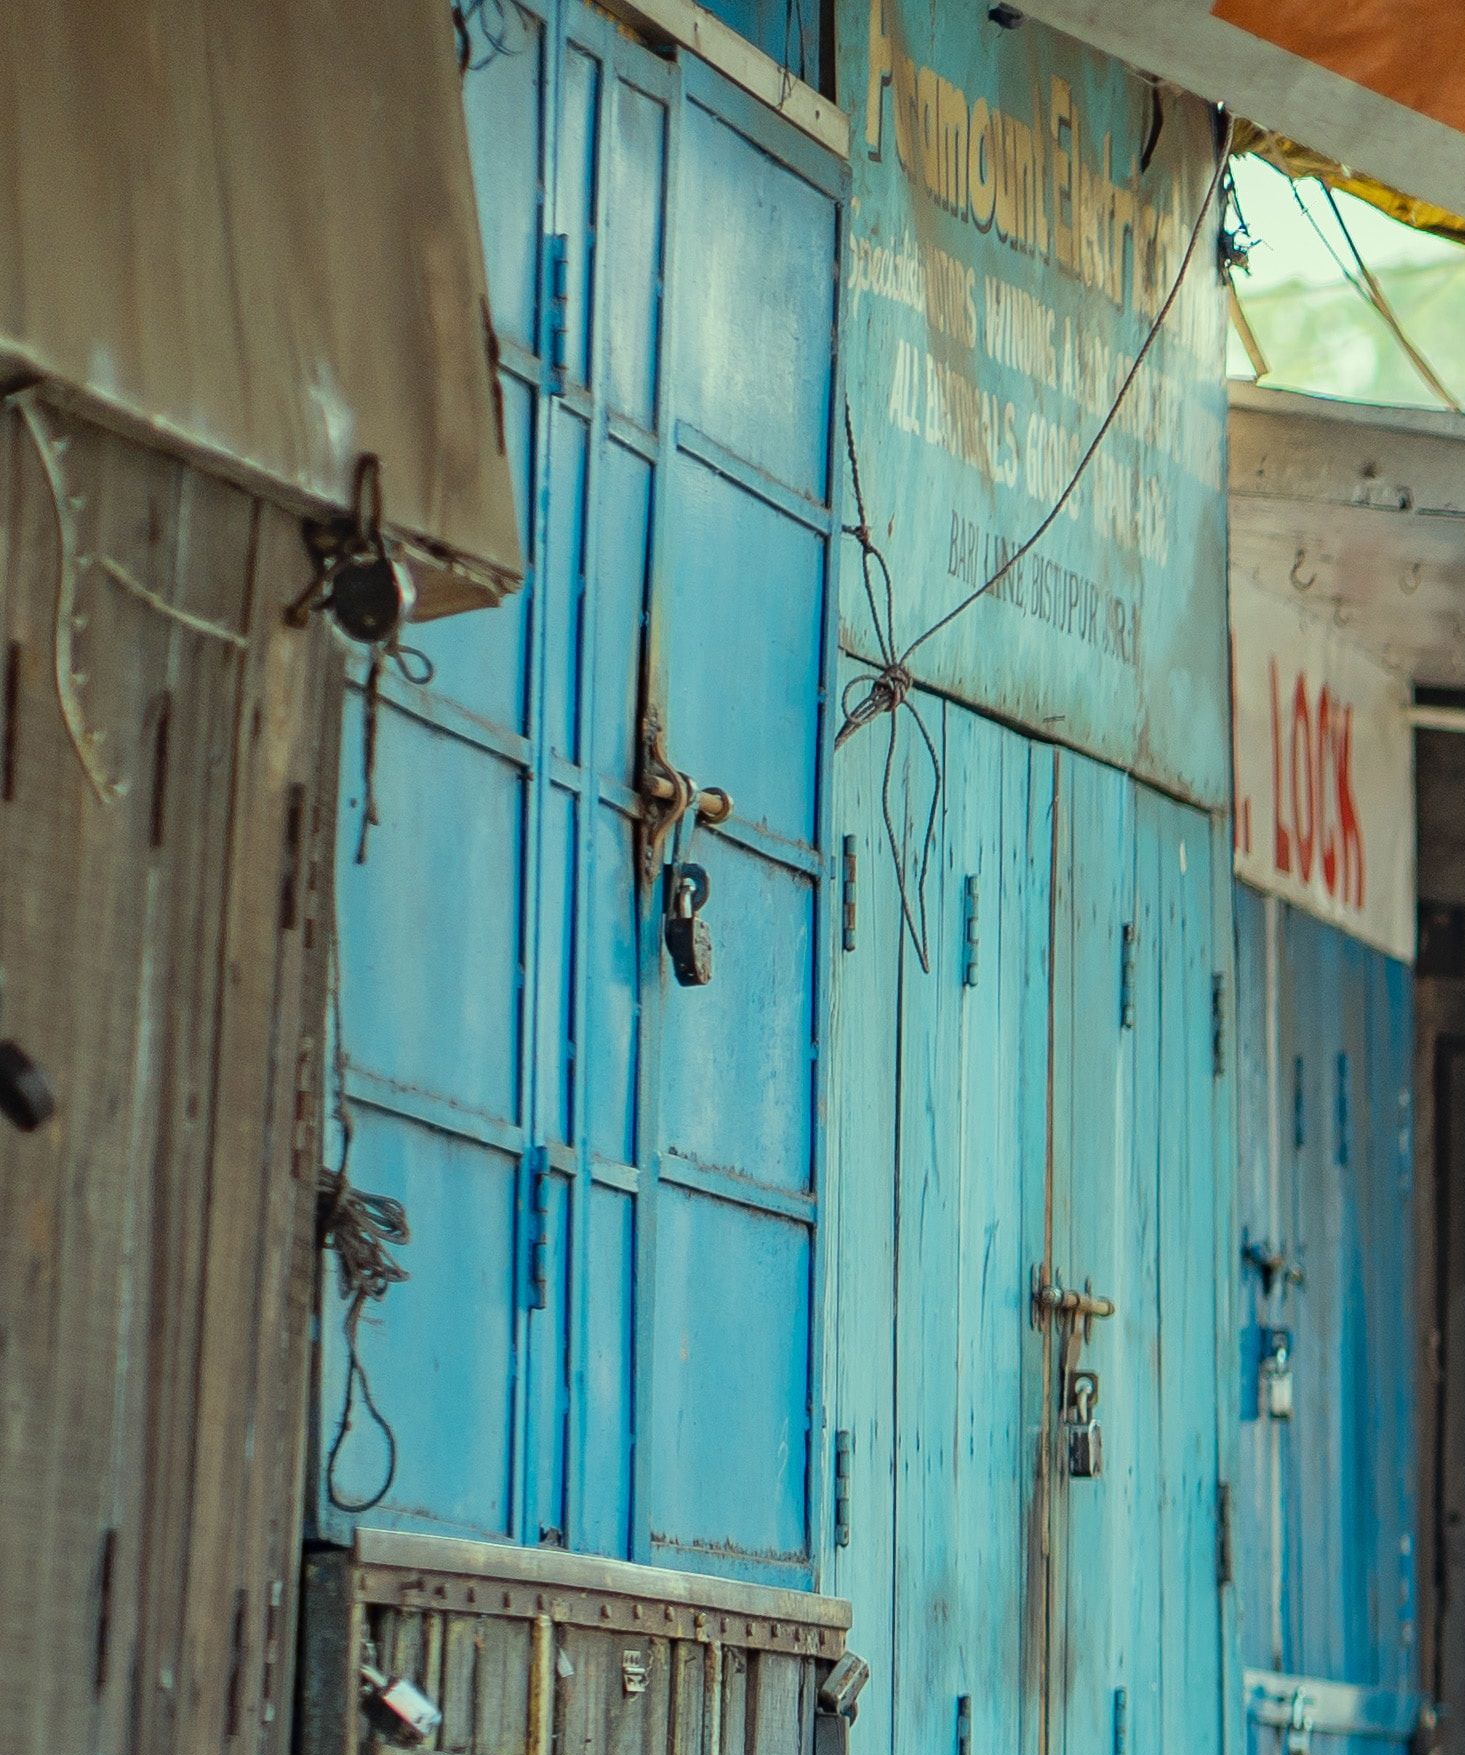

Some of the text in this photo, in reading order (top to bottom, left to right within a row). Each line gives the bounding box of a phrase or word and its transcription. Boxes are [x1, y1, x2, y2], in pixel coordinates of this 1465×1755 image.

[984, 277, 1057, 389] WINDING
[890, 339, 920, 436] ALL
[947, 509, 980, 588] BARI
[1269, 655, 1366, 913] LOCK
